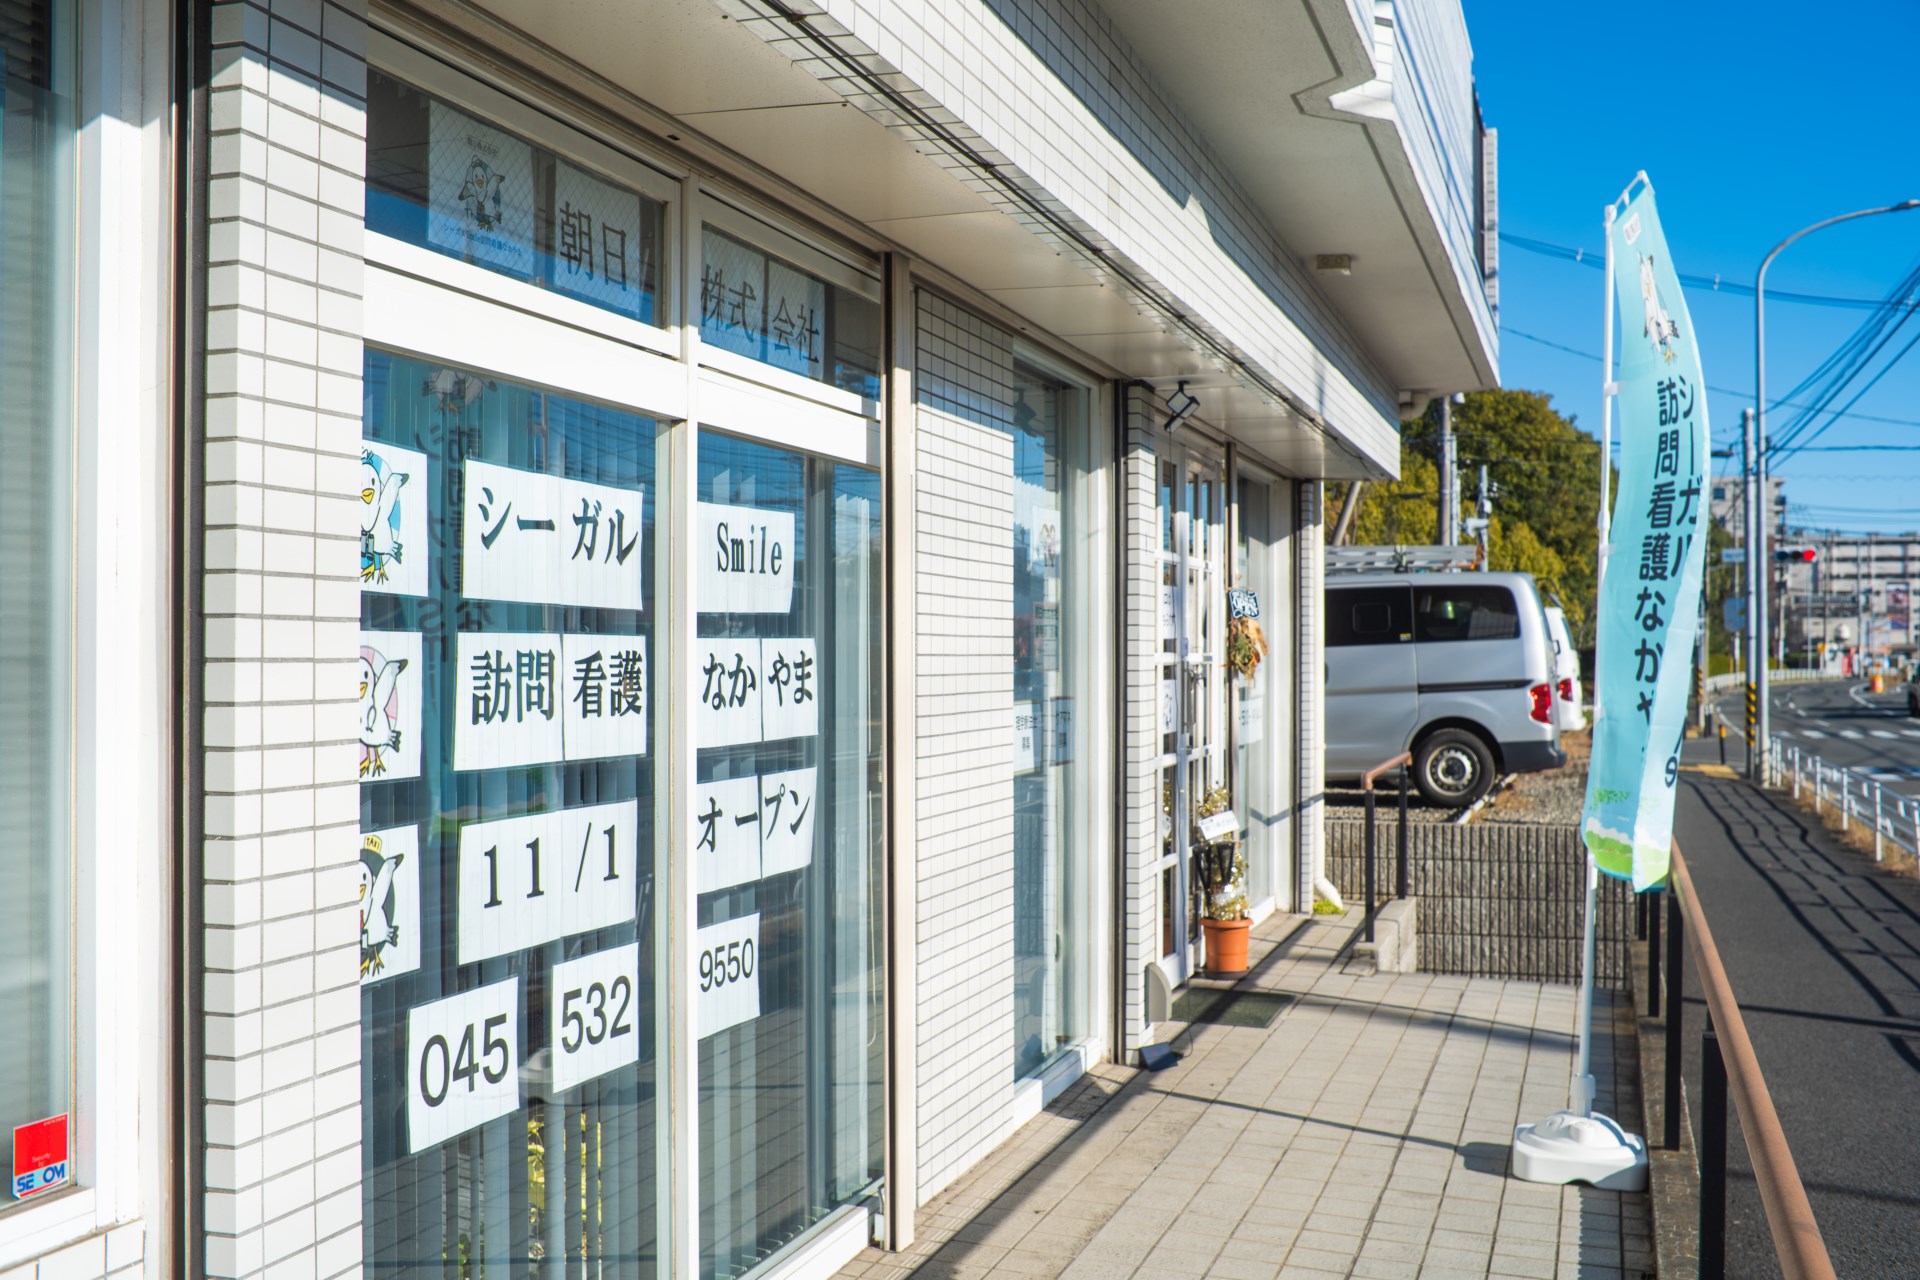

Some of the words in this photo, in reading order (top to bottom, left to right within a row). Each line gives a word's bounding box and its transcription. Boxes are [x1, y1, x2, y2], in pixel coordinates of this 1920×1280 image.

[559, 201, 627, 292] 朝日
[700, 263, 820, 364] 株式会社
[478, 486, 638, 566] シーガル
[717, 522, 783, 575] Smile
[470, 649, 643, 725] 訪問看護
[702, 651, 814, 710] なかやま
[698, 783, 811, 853] オープン
[420, 1013, 510, 1108] 045
[562, 975, 632, 1054] 532
[699, 938, 754, 993] 9550
[17, 1163, 65, 1193] SECOM
